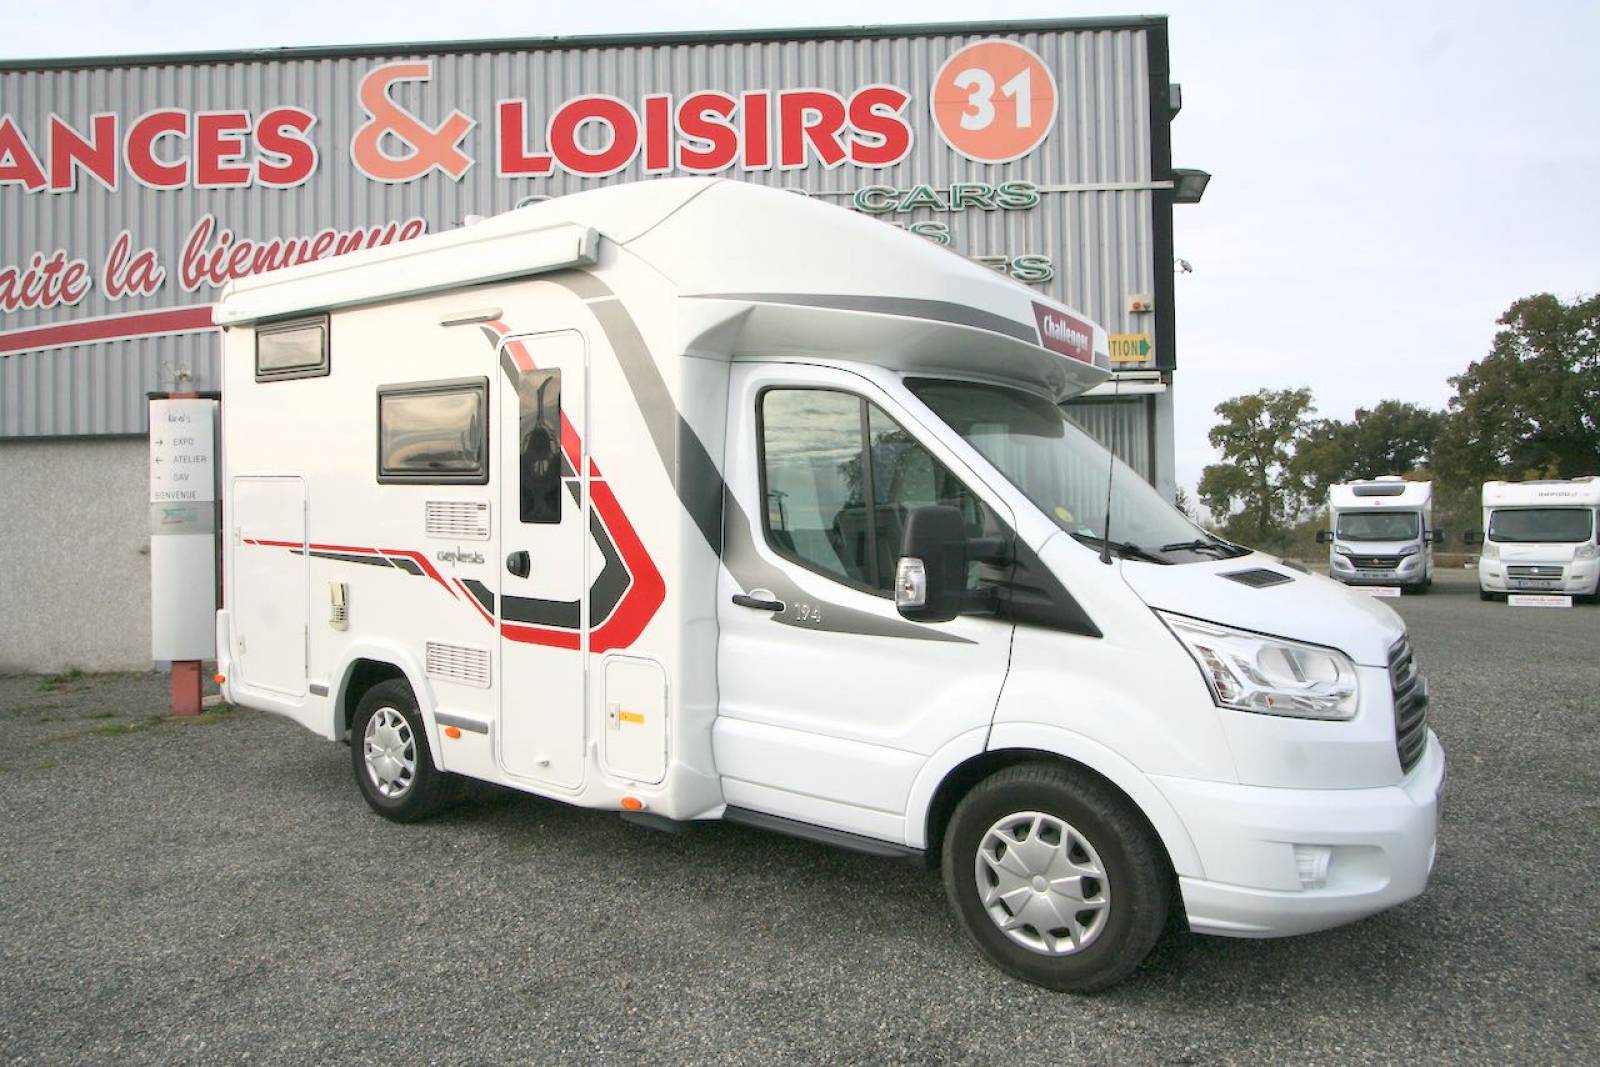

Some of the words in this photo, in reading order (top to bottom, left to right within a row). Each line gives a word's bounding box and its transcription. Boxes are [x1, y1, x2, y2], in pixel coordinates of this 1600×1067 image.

[952, 66, 1034, 131] 31
[353, 60, 476, 182] &
[498, 86, 912, 176] LOISIRS
[853, 180, 1040, 213] CARS
[105, 232, 164, 298] la
[1043, 314, 1089, 352] Challenger
[1108, 339, 1138, 357] TION
[173, 455, 208, 464] ATELIER
